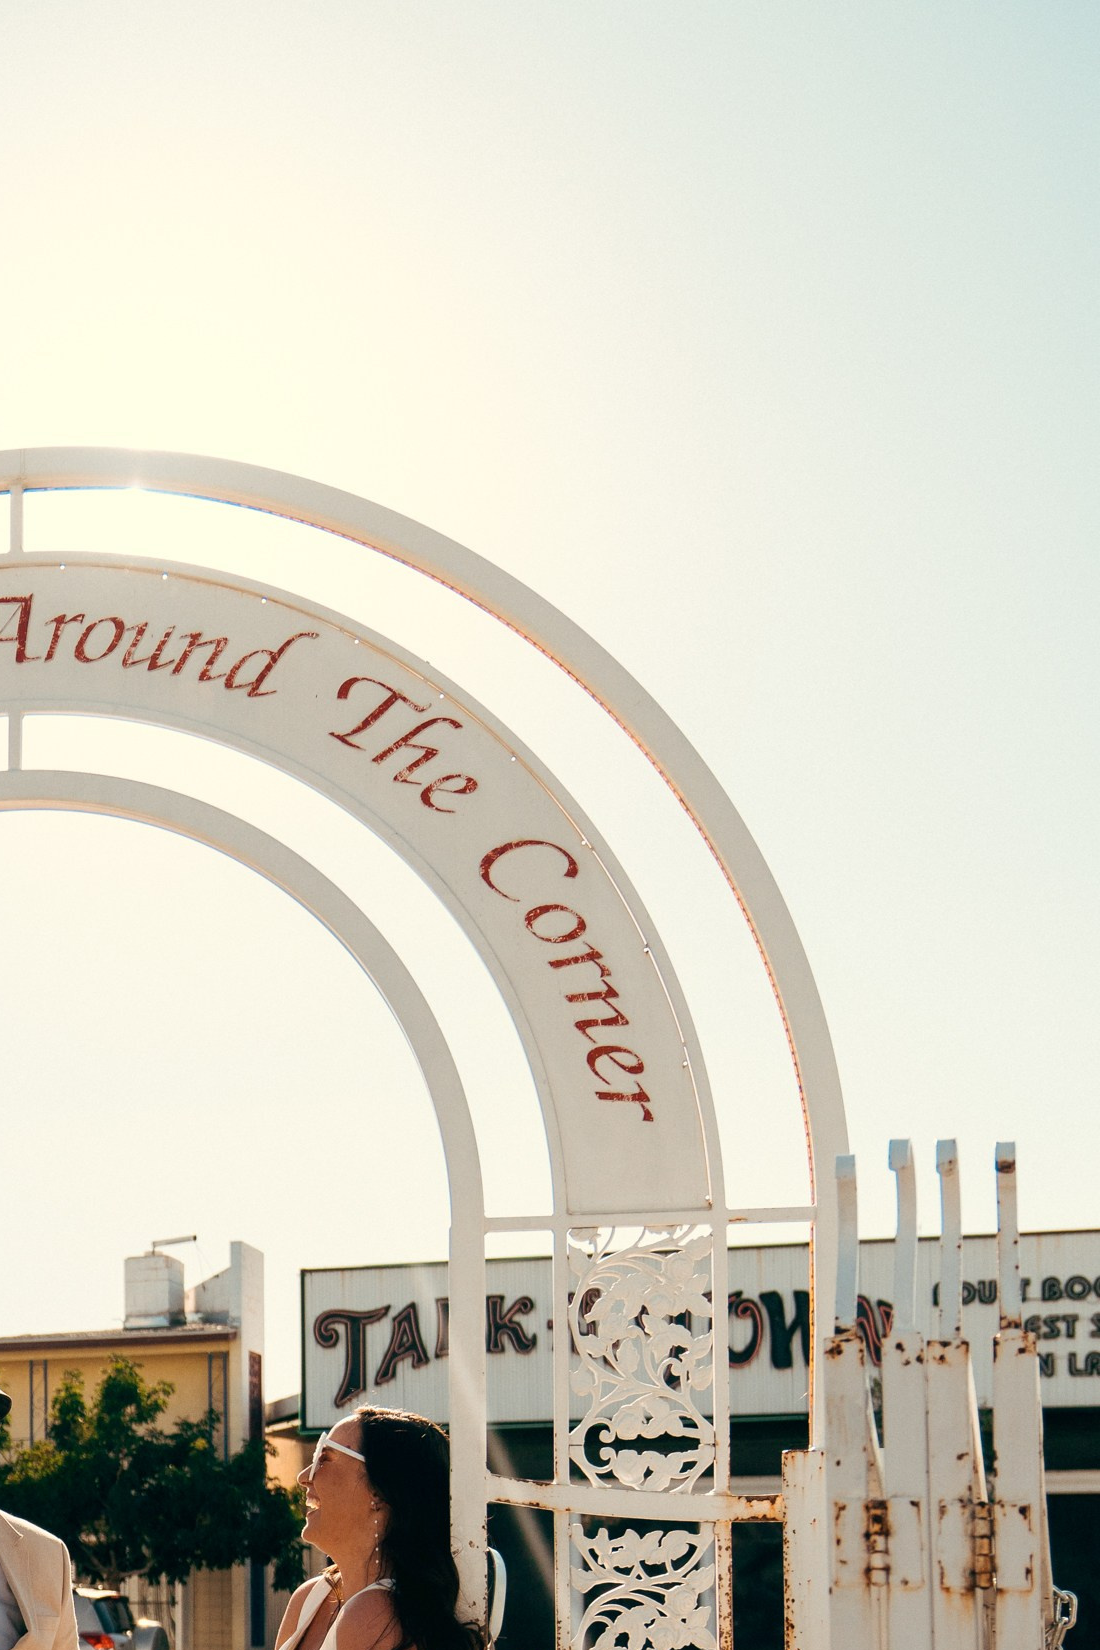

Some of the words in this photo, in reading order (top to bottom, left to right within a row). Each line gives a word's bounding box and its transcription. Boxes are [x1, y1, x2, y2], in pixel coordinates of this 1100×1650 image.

[327, 675, 479, 814] The
[478, 838, 655, 1123] Corner
[932, 1279, 1031, 1307] DUT
[1041, 1275, 1100, 1303] BO
